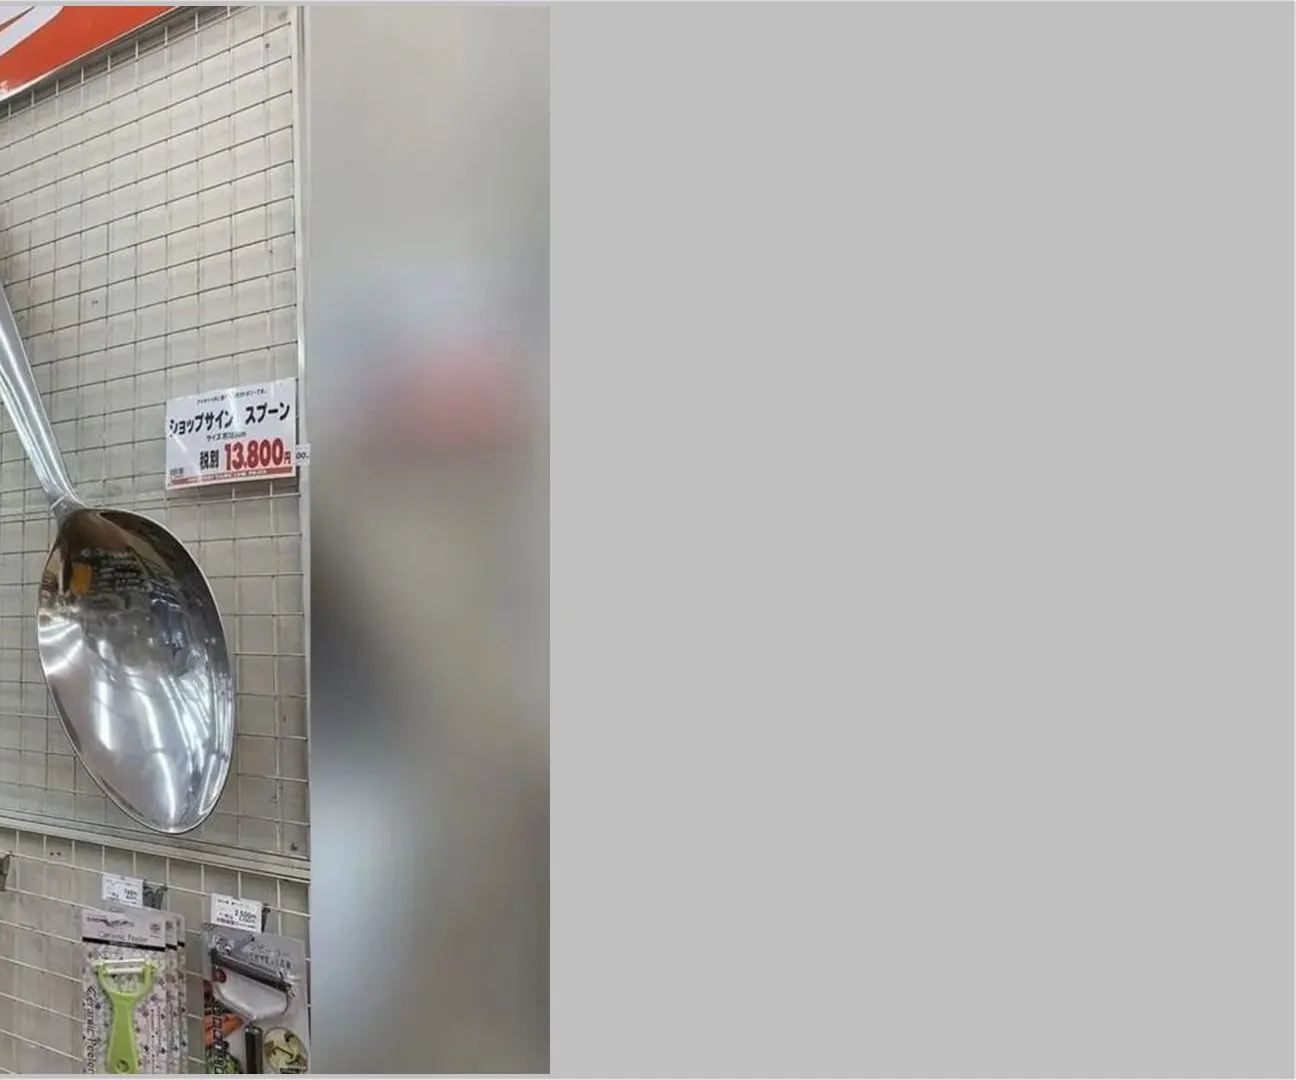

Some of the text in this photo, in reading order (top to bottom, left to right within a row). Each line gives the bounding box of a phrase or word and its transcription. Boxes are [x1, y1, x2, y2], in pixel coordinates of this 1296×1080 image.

[169, 402, 290, 435] ショップサイン スプーン
[199, 449, 219, 471] 税別
[86, 985, 97, 1035] Ceramic
